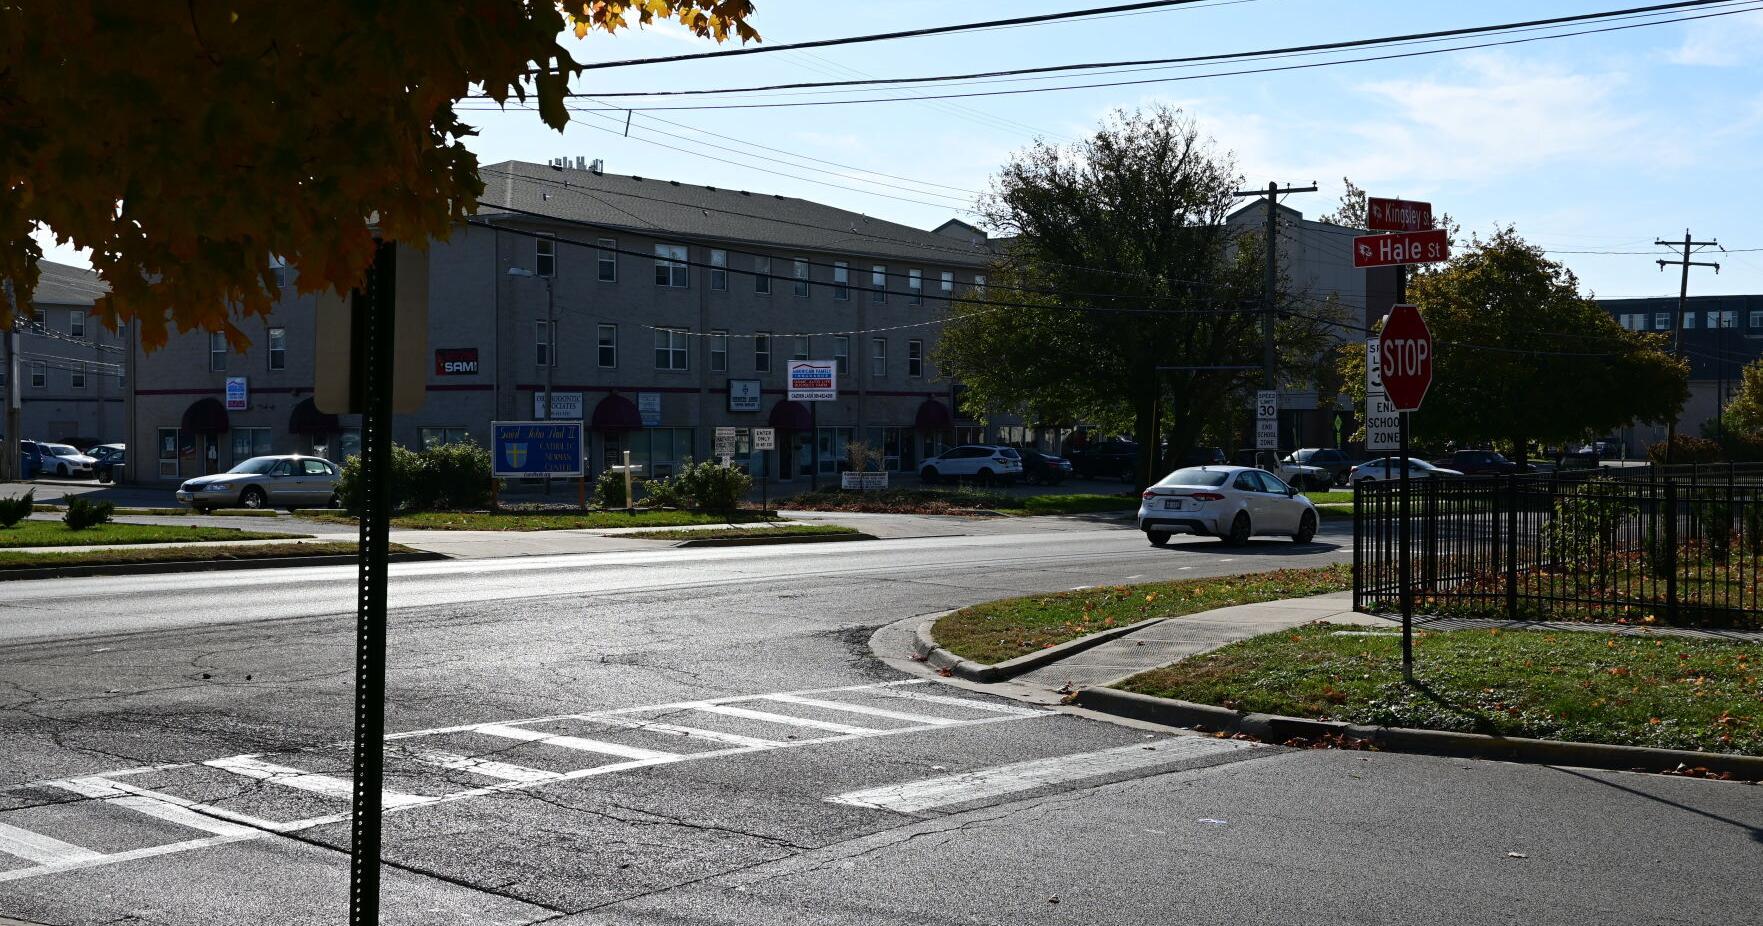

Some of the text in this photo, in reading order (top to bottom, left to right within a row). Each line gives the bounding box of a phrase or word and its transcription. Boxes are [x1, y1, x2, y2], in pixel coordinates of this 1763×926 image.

[1385, 202, 1421, 230] Kingsley
[1379, 238, 1440, 261] Hale St
[1383, 338, 1428, 377] STOP
[1259, 405, 1275, 416] 30
[1368, 416, 1400, 429] SCHOO
[1373, 432, 1401, 444] ZONE
